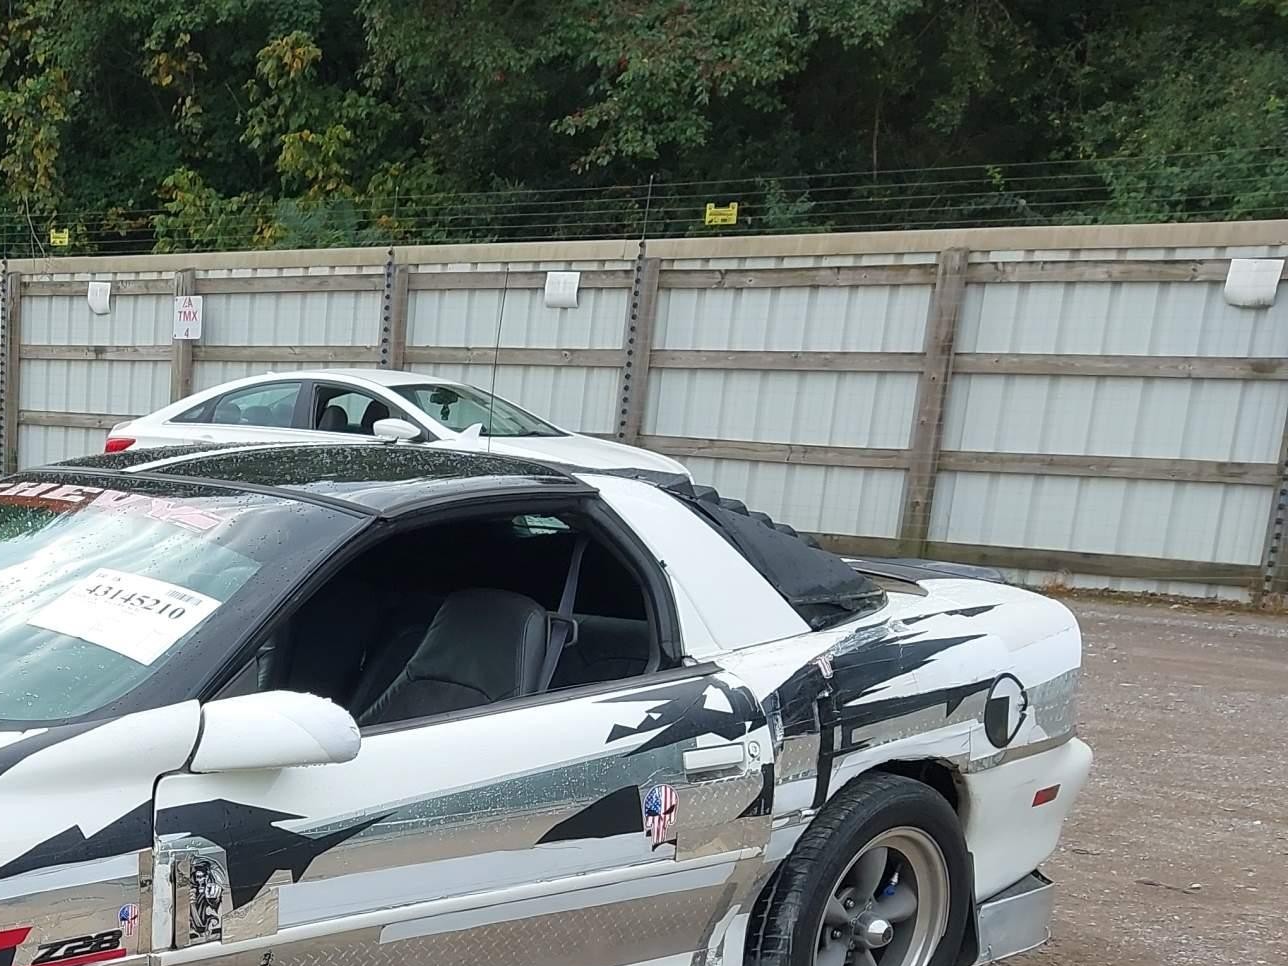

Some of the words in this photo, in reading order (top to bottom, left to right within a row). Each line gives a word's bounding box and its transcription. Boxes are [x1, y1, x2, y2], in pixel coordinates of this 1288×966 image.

[177, 310, 198, 321] TMX
[184, 327, 190, 338] 4
[85, 584, 187, 620] 43145210
[31, 929, 123, 966] Z28
